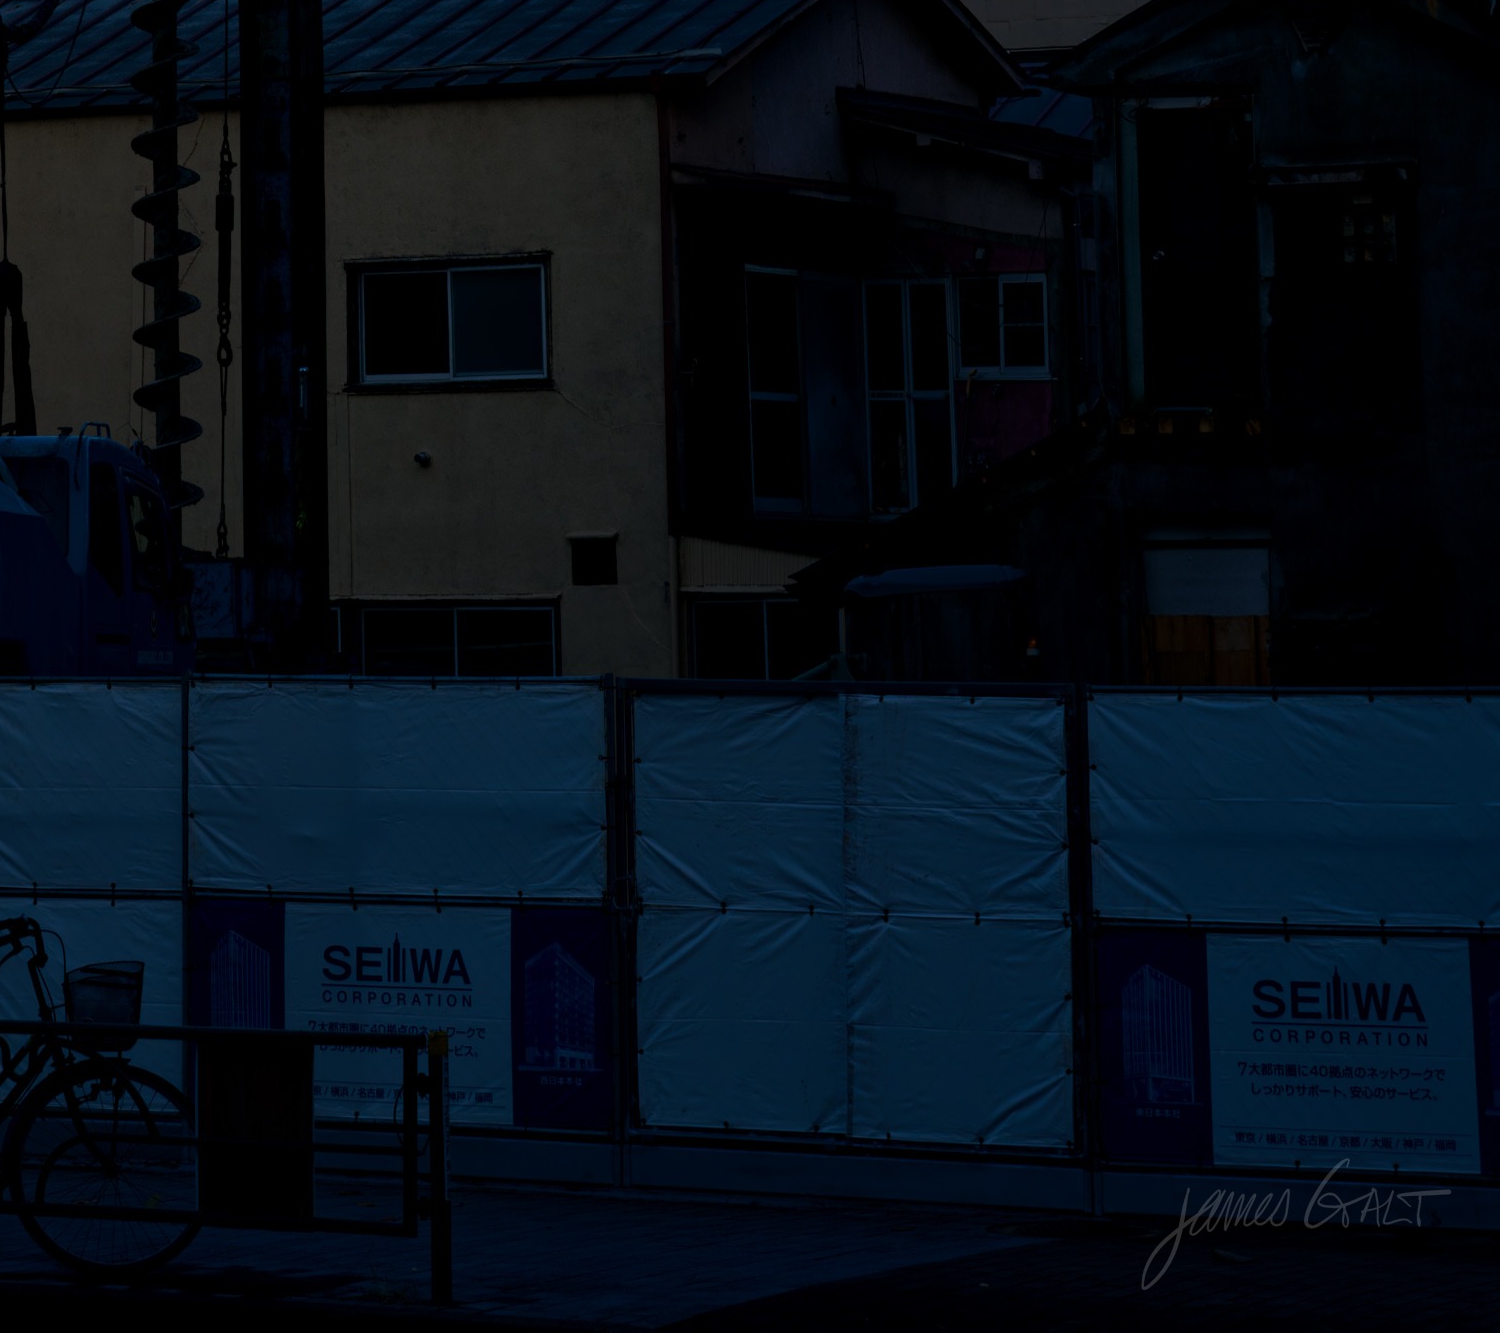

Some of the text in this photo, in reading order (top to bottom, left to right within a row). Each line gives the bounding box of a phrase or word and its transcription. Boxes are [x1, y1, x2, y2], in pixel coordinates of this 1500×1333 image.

[322, 932, 471, 985] SEIWA
[322, 989, 473, 1008] CORPORATION
[1252, 966, 1426, 1023] SEIWA
[1252, 1027, 1429, 1048] CORPORATION
